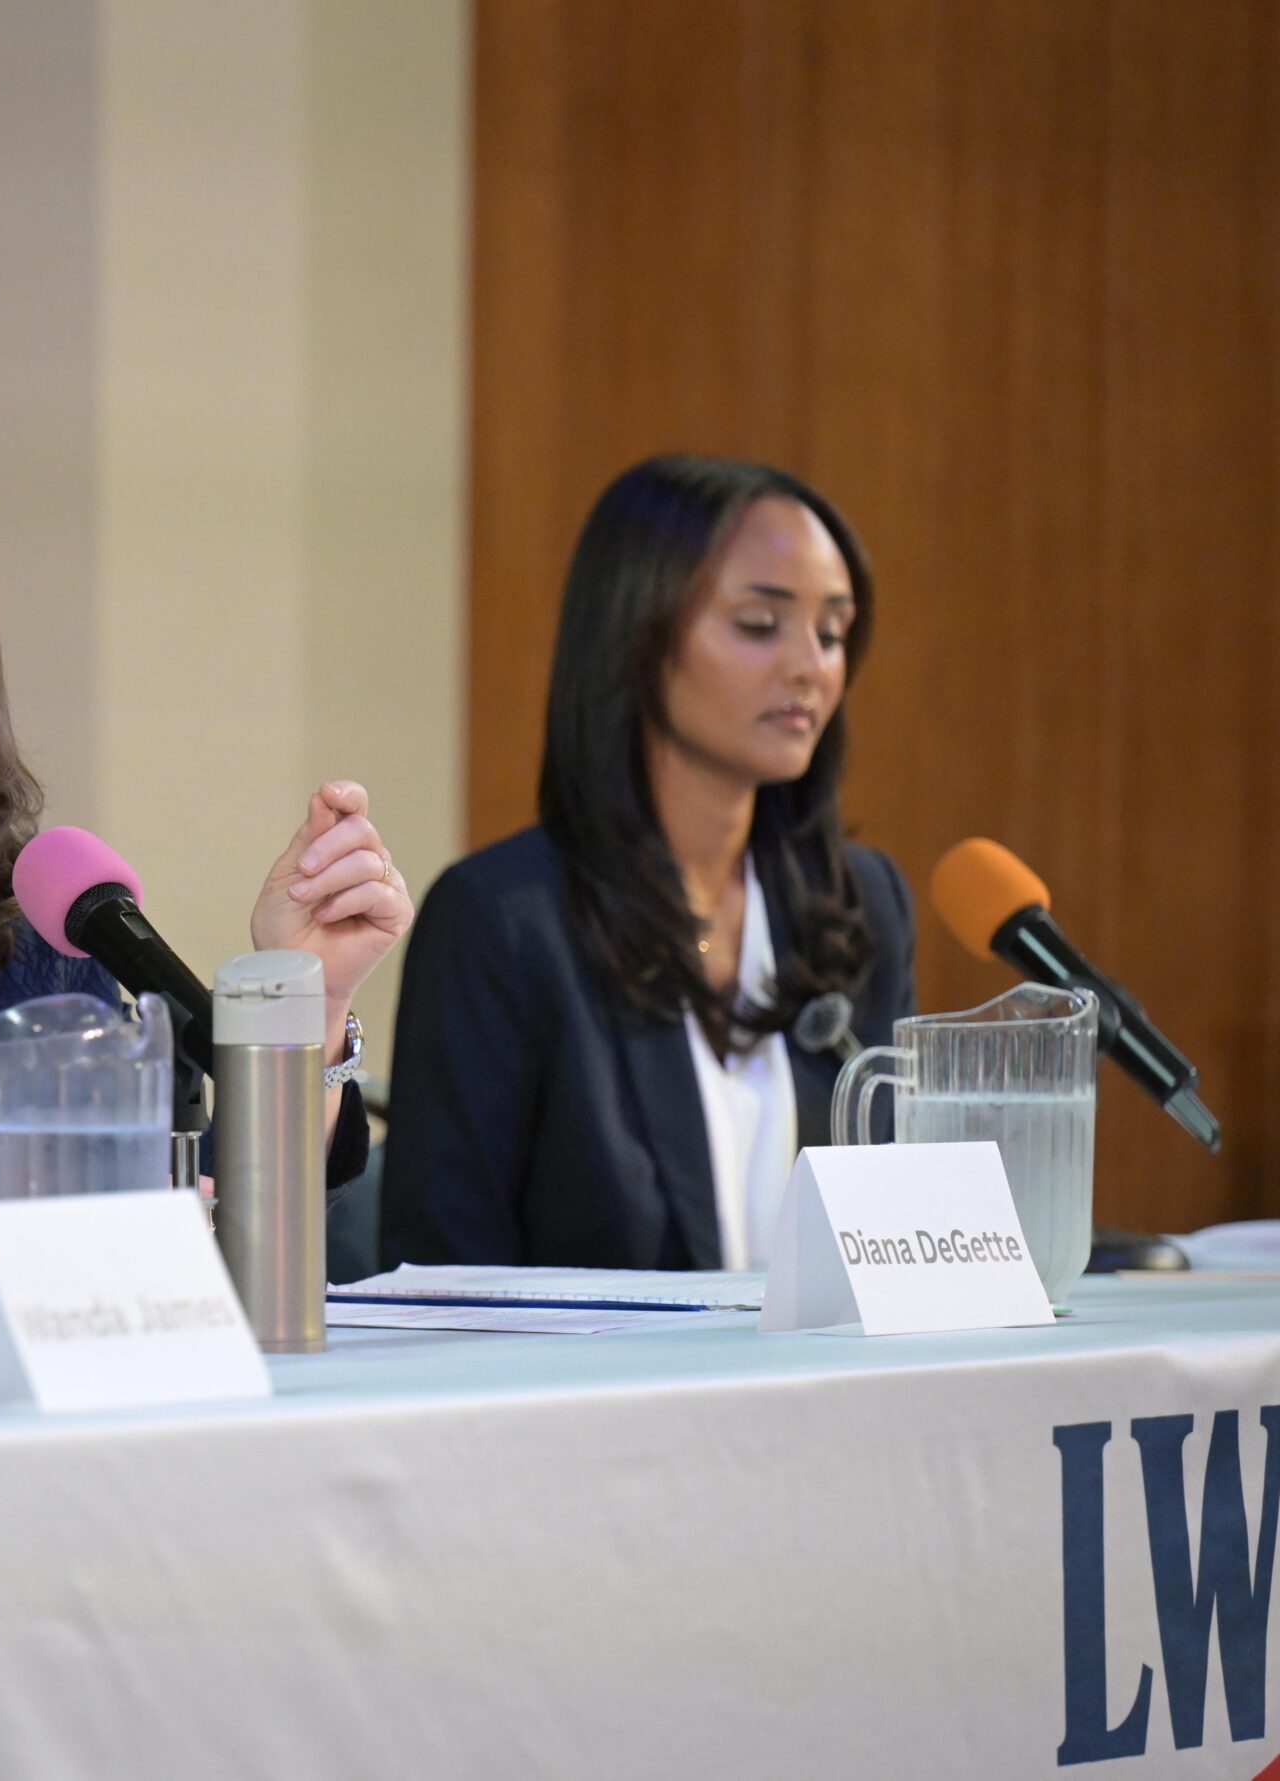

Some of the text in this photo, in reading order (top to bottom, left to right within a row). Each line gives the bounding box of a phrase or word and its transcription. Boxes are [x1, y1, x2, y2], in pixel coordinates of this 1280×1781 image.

[839, 1229, 1023, 1265] Diana DeGette
[20, 1295, 237, 1342] Wanda James
